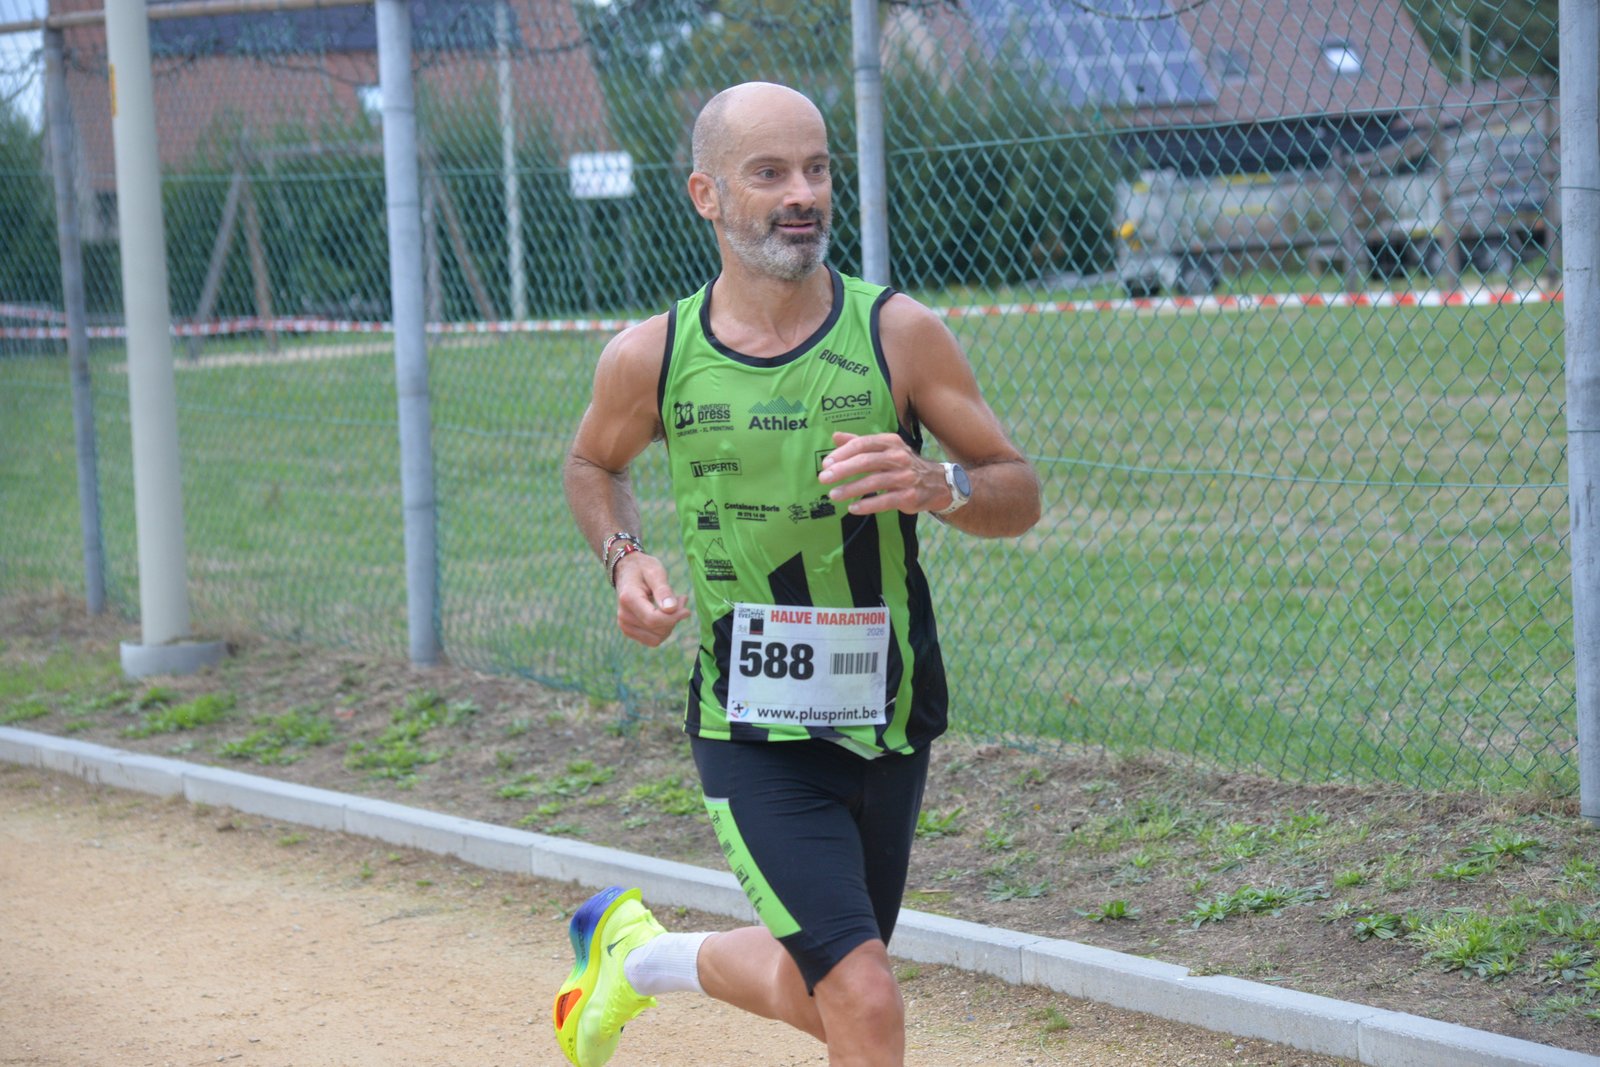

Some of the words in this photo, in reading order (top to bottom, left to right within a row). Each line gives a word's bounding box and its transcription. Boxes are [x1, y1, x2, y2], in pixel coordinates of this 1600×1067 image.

[698, 409, 730, 423] press
[748, 415, 809, 431] Athlex
[724, 502, 759, 511] Containers
[770, 609, 812, 624] HALVE
[817, 612, 885, 625] MARATHON
[739, 640, 814, 680] 588
[757, 705, 878, 724] www.plusprint.be
